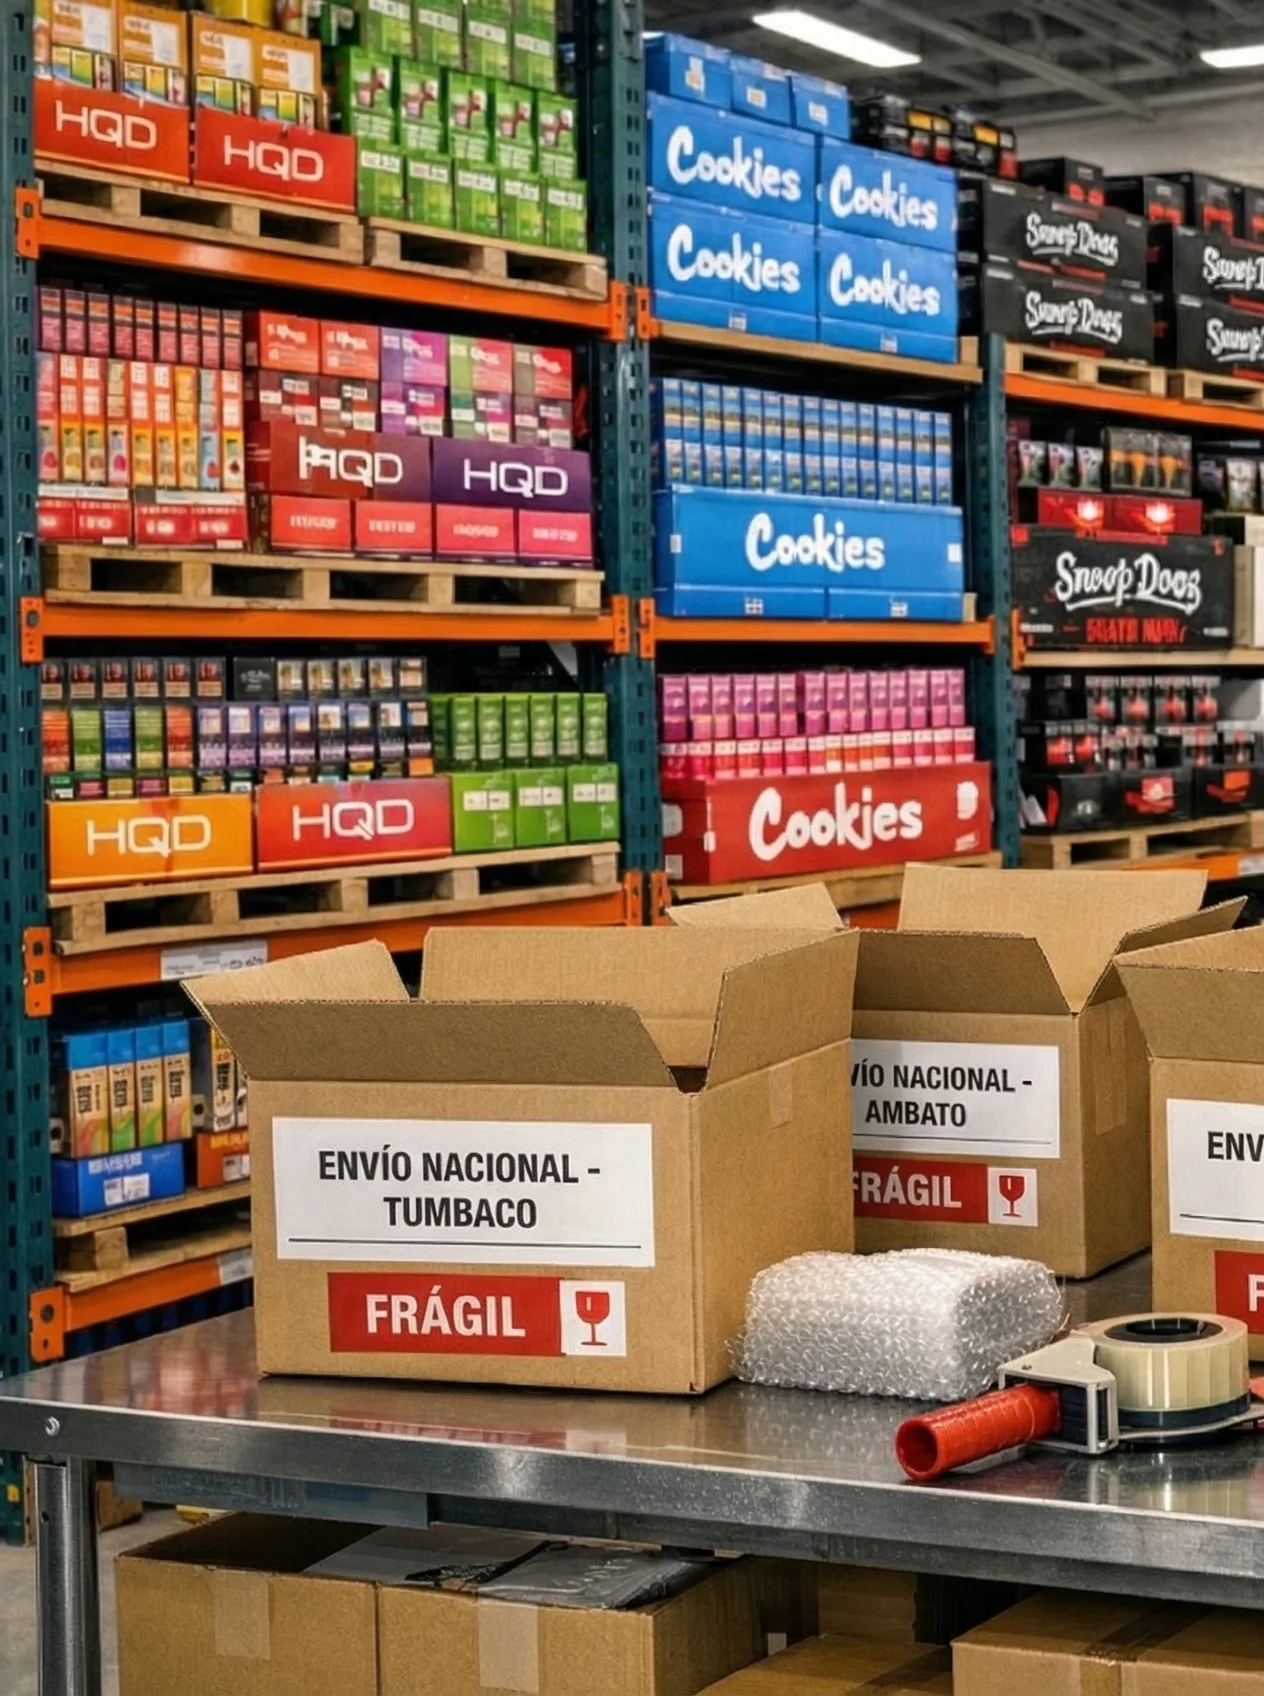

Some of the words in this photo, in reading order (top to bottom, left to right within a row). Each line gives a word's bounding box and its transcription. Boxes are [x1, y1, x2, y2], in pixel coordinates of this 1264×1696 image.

[55, 100, 157, 150] HQD
[224, 135, 323, 182] HQD
[667, 126, 801, 201] Cookies
[830, 165, 938, 231] Cookies
[667, 224, 800, 293] Cookies
[830, 254, 940, 316] Cookies
[464, 458, 568, 497] HQD
[746, 512, 886, 573] Cookies
[1055, 551, 1134, 607] Snoop
[87, 815, 211, 858] HQD
[292, 799, 414, 840] HQD
[749, 779, 923, 861] Cookies
[893, 1065, 1015, 1092] NACIONAL
[865, 1100, 967, 1127] AMBATO
[319, 1145, 412, 1181] ENVÍO
[423, 1152, 579, 1184] NACIONAL
[383, 1197, 537, 1229] TUMBACO
[365, 1285, 526, 1337] FRÁGIL
